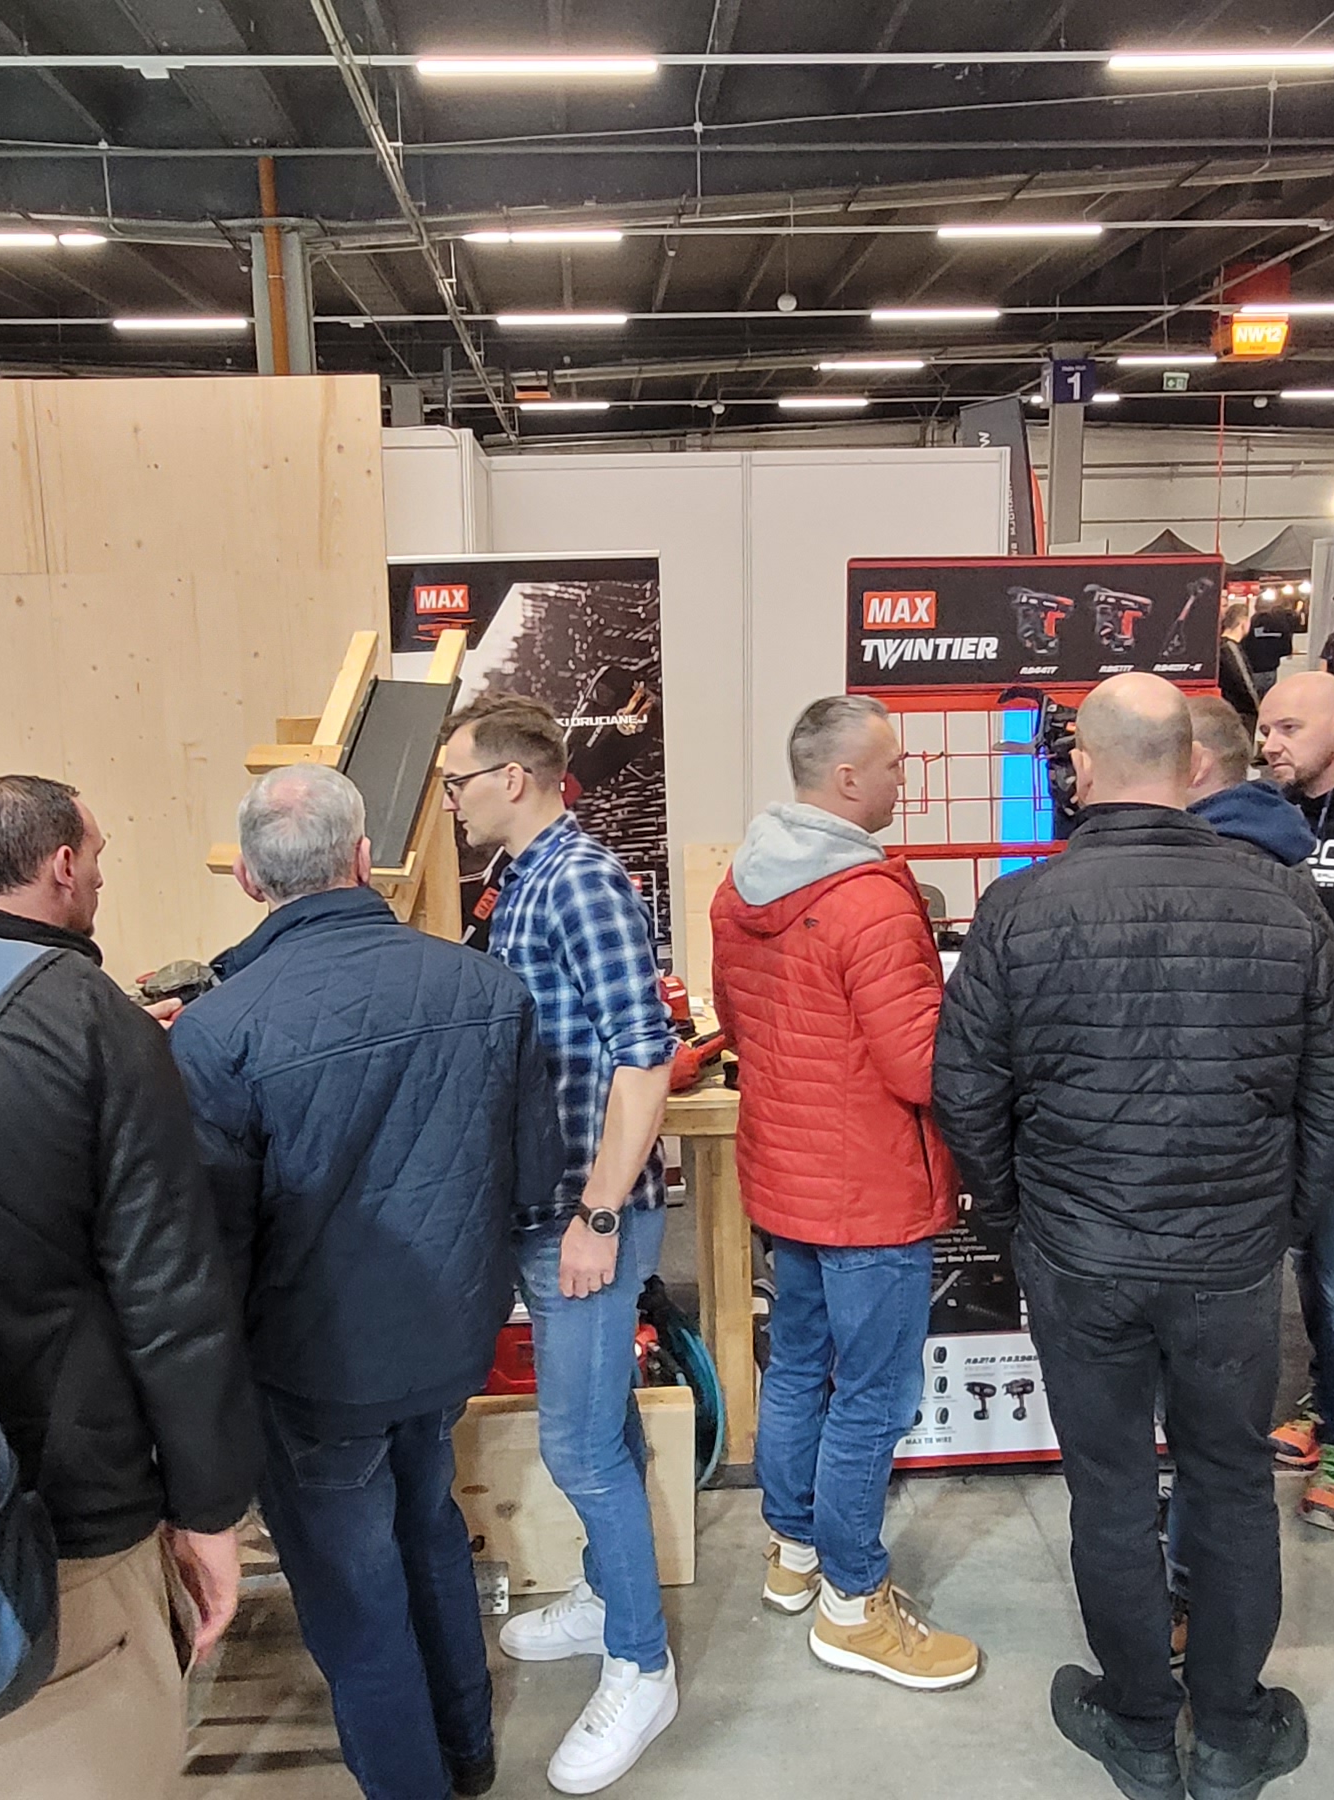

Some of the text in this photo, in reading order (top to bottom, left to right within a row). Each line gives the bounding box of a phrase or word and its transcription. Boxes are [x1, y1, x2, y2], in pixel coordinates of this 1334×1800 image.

[1235, 326, 1282, 343] NW12
[1067, 372, 1080, 400] 1
[419, 588, 465, 609] MAX
[867, 597, 932, 624] MAX
[860, 636, 1000, 670] TWINTIER
